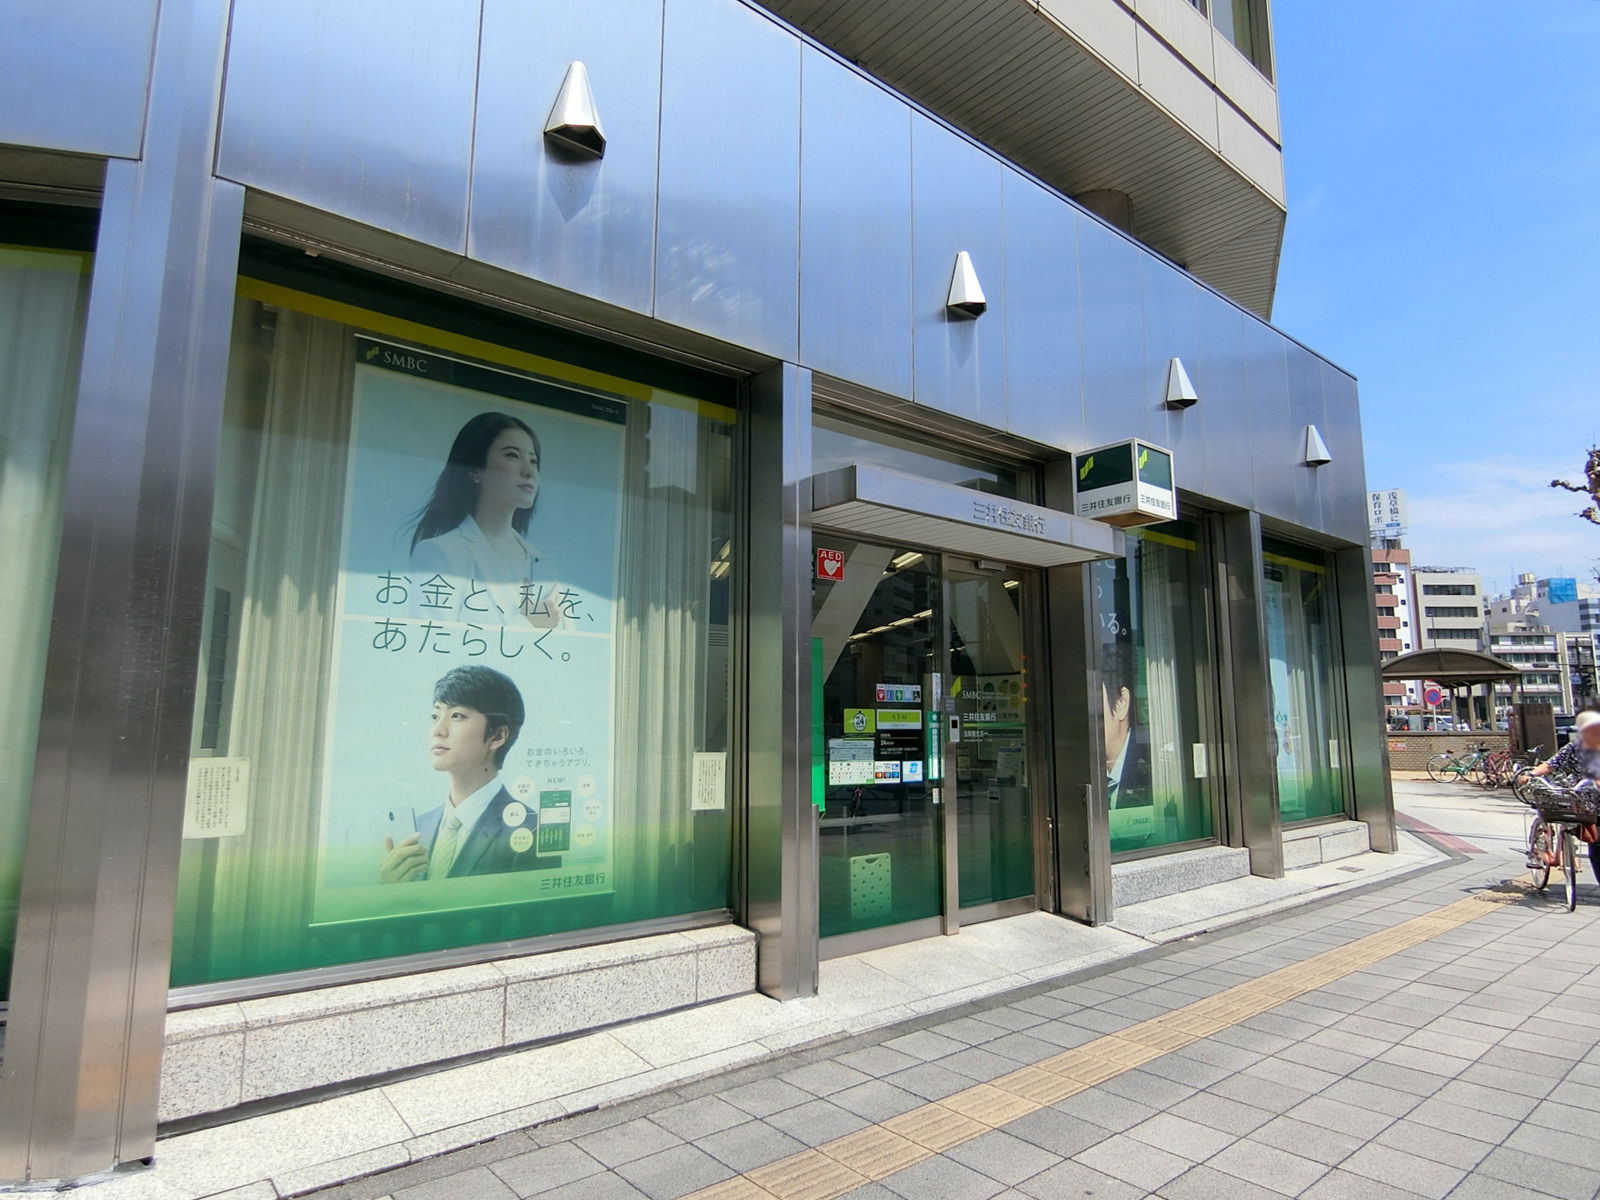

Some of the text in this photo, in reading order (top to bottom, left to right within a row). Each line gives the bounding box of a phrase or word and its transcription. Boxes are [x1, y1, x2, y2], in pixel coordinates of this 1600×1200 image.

[383, 350, 428, 373] SMBC
[1082, 494, 1131, 512] 三井住友銀行
[1141, 494, 1171, 511] 三井住友銀行
[1388, 491, 1399, 522] 浅草橋に
[973, 501, 1045, 535] 三井住友銀行
[820, 550, 842, 560] AED
[376, 570, 593, 622] お金と、私を、
[372, 617, 571, 662] あたらしく。
[962, 690, 981, 699] SMBC
[855, 716, 865, 725] 24
[891, 713, 908, 721] ATM
[963, 712, 996, 721] 三井住友銀行
[526, 746, 589, 757] お金のいろいろ、
[526, 757, 592, 769] できちゃうアプリ。
[540, 873, 606, 890] 三井住友銀行
